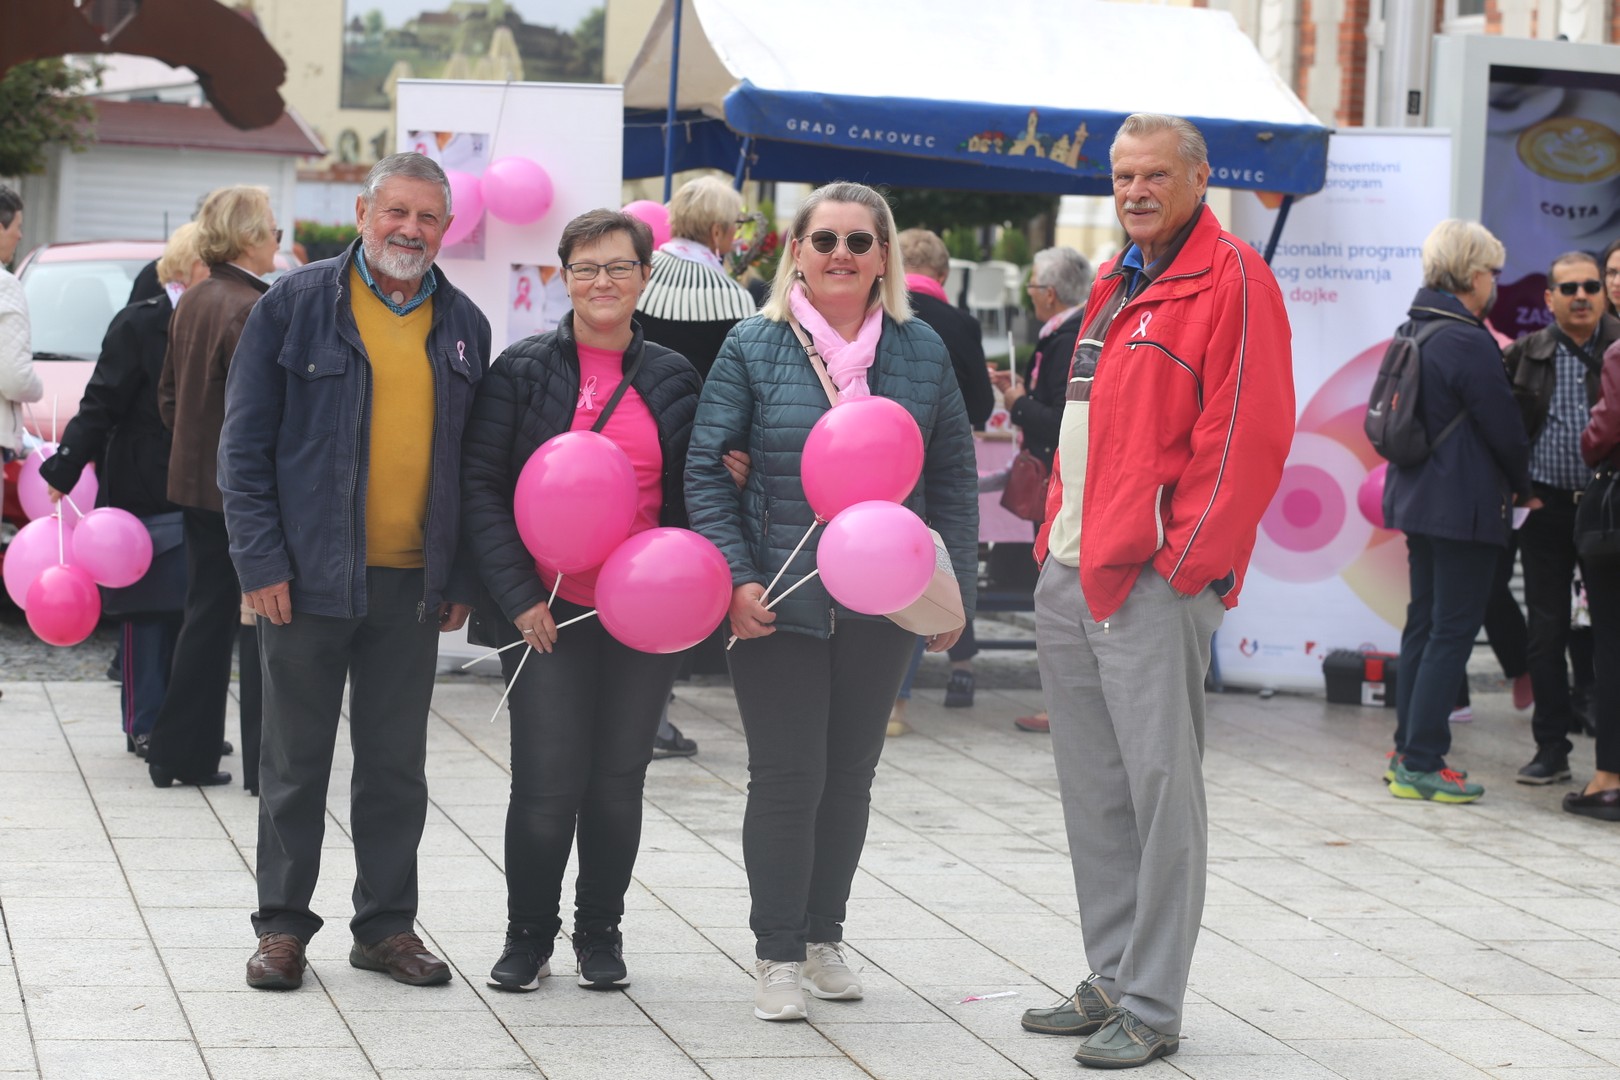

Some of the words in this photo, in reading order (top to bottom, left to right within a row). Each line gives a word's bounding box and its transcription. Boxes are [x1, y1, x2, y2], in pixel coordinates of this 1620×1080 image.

[787, 119, 836, 135] GRAD
[1540, 202, 1598, 219] COSTA
[1348, 244, 1423, 261] program
[1305, 265, 1390, 283] otkrivanja
[1290, 287, 1337, 305] dojke
